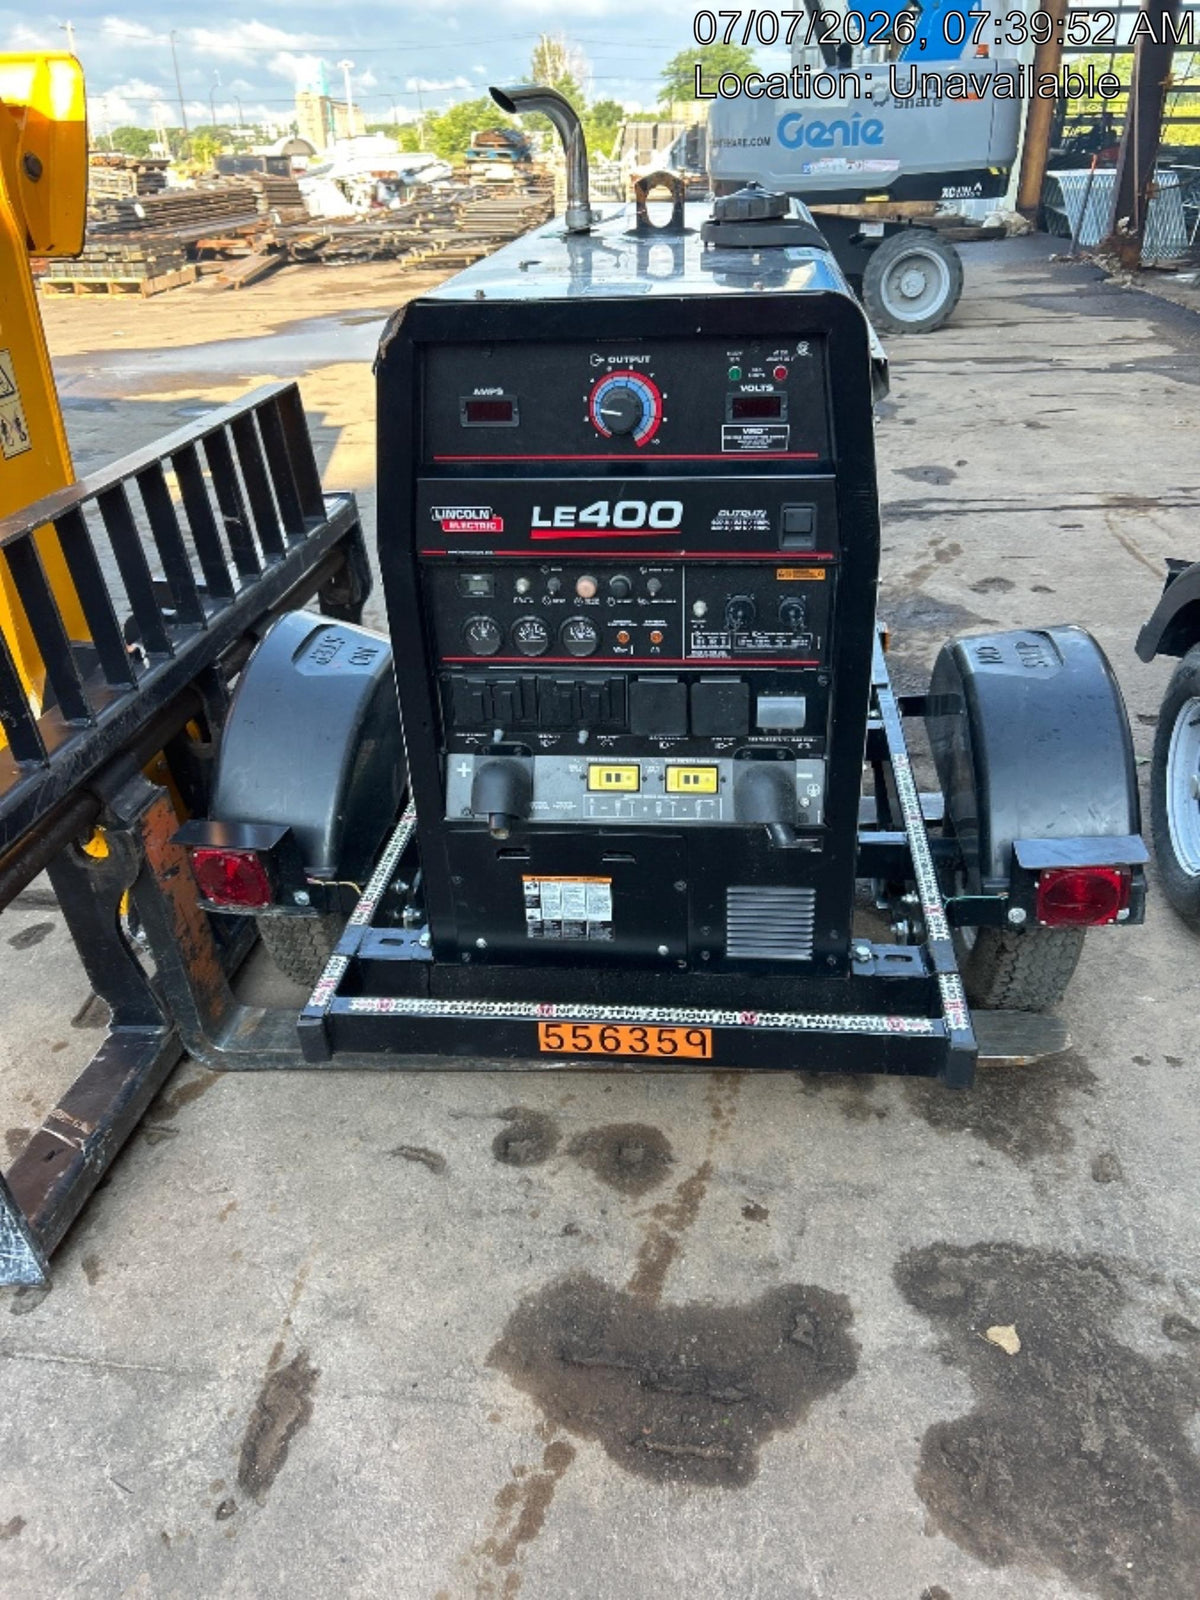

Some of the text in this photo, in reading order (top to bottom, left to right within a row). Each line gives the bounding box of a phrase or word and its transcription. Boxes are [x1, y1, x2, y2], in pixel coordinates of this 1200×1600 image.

[777, 111, 884, 150] Genie
[607, 355, 651, 364] OUTPUT
[473, 387, 504, 396] AMPS
[741, 384, 774, 392] VOLTS
[433, 508, 491, 520] LINCOLN
[531, 500, 684, 529] LE400
[448, 521, 497, 530] ELECTRIC
[544, 1023, 707, 1056] 556359
